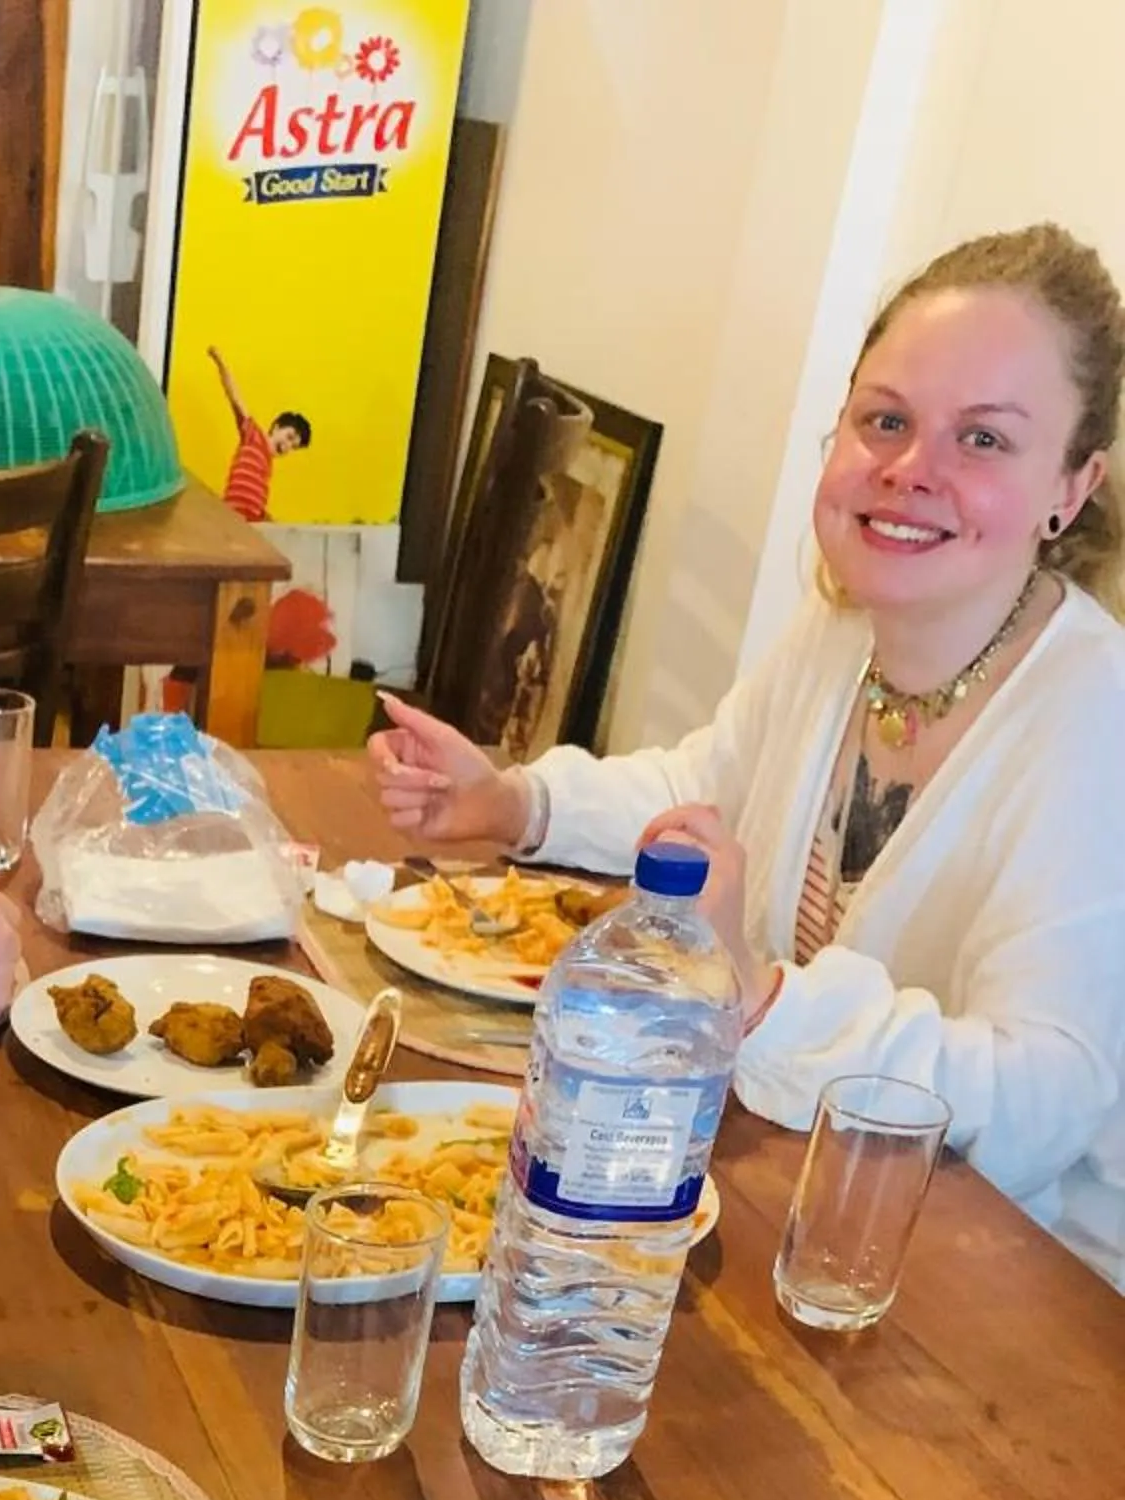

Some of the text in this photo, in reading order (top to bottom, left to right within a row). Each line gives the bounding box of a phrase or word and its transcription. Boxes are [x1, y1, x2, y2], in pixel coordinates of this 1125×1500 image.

[227, 84, 416, 161] Astra
[261, 167, 370, 197] Good Start
